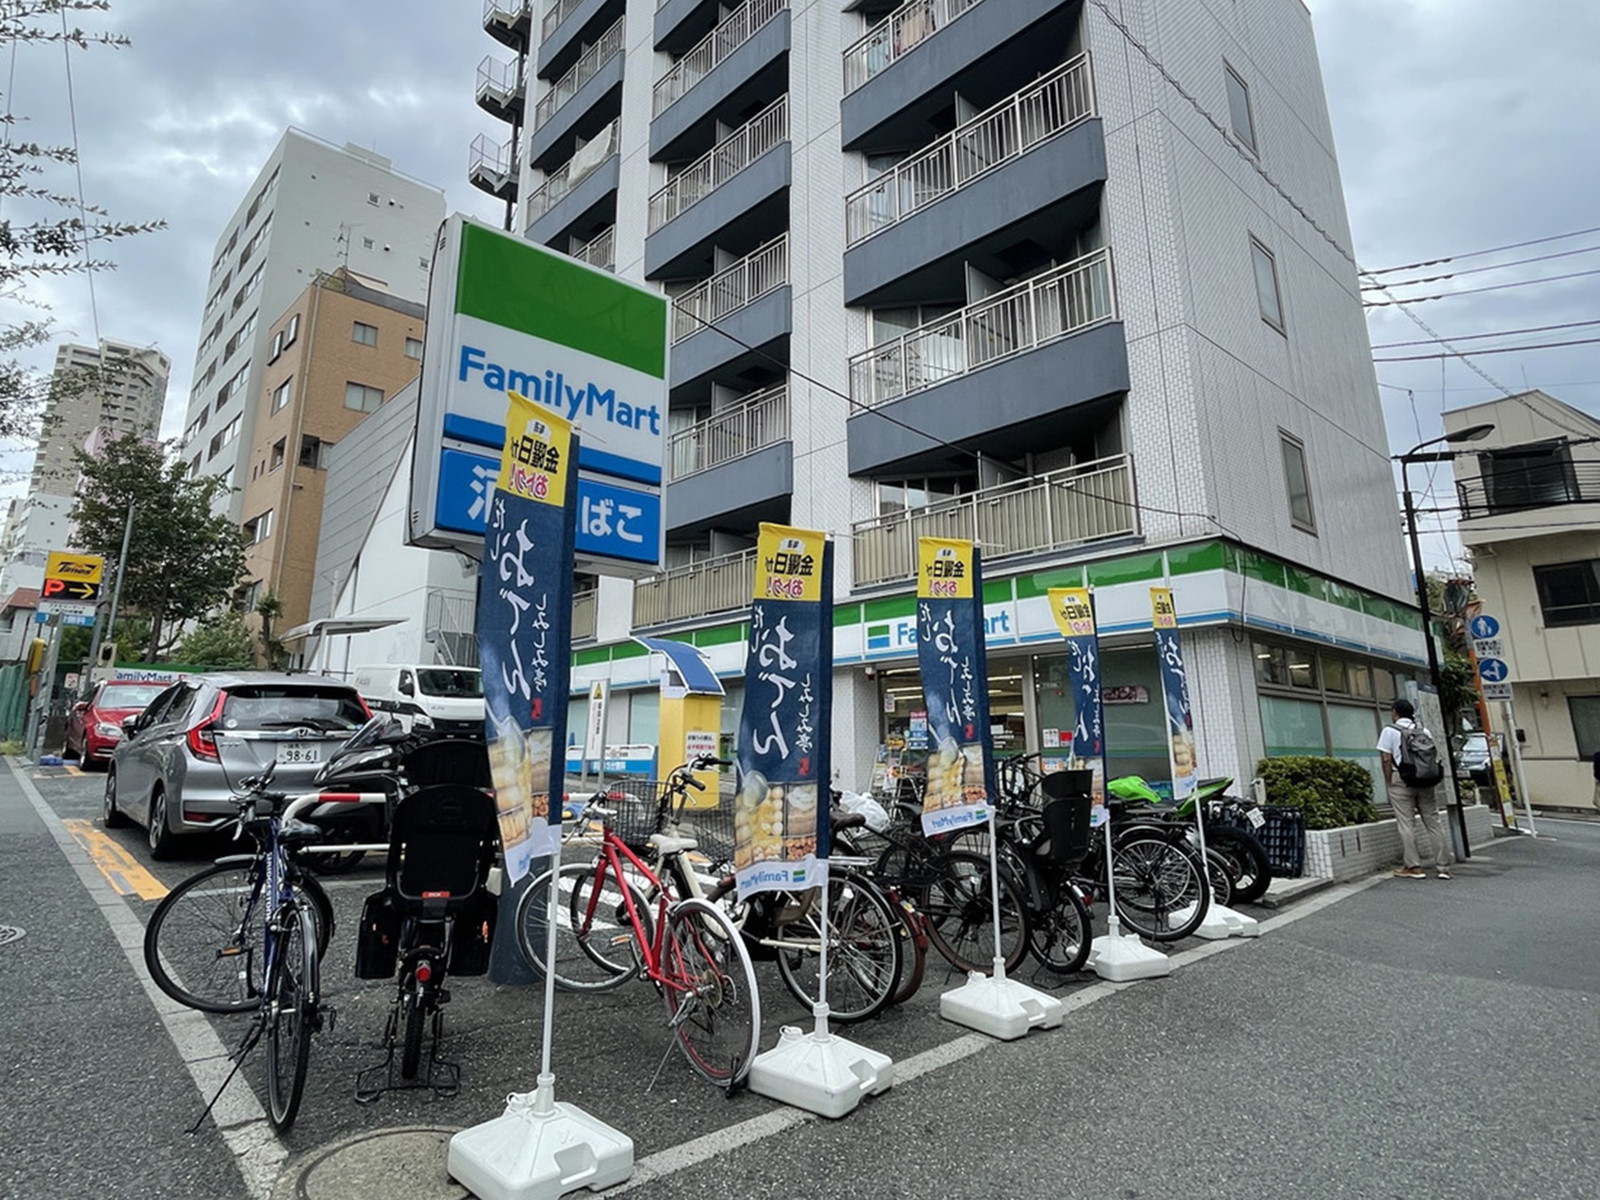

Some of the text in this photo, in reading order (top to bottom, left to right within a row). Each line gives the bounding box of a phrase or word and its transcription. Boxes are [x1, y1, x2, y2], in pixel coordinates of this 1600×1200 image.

[459, 345, 660, 435] FamilyMart
[573, 495, 643, 543] ばこ
[58, 561, 97, 575] Times
[44, 579, 66, 596] P
